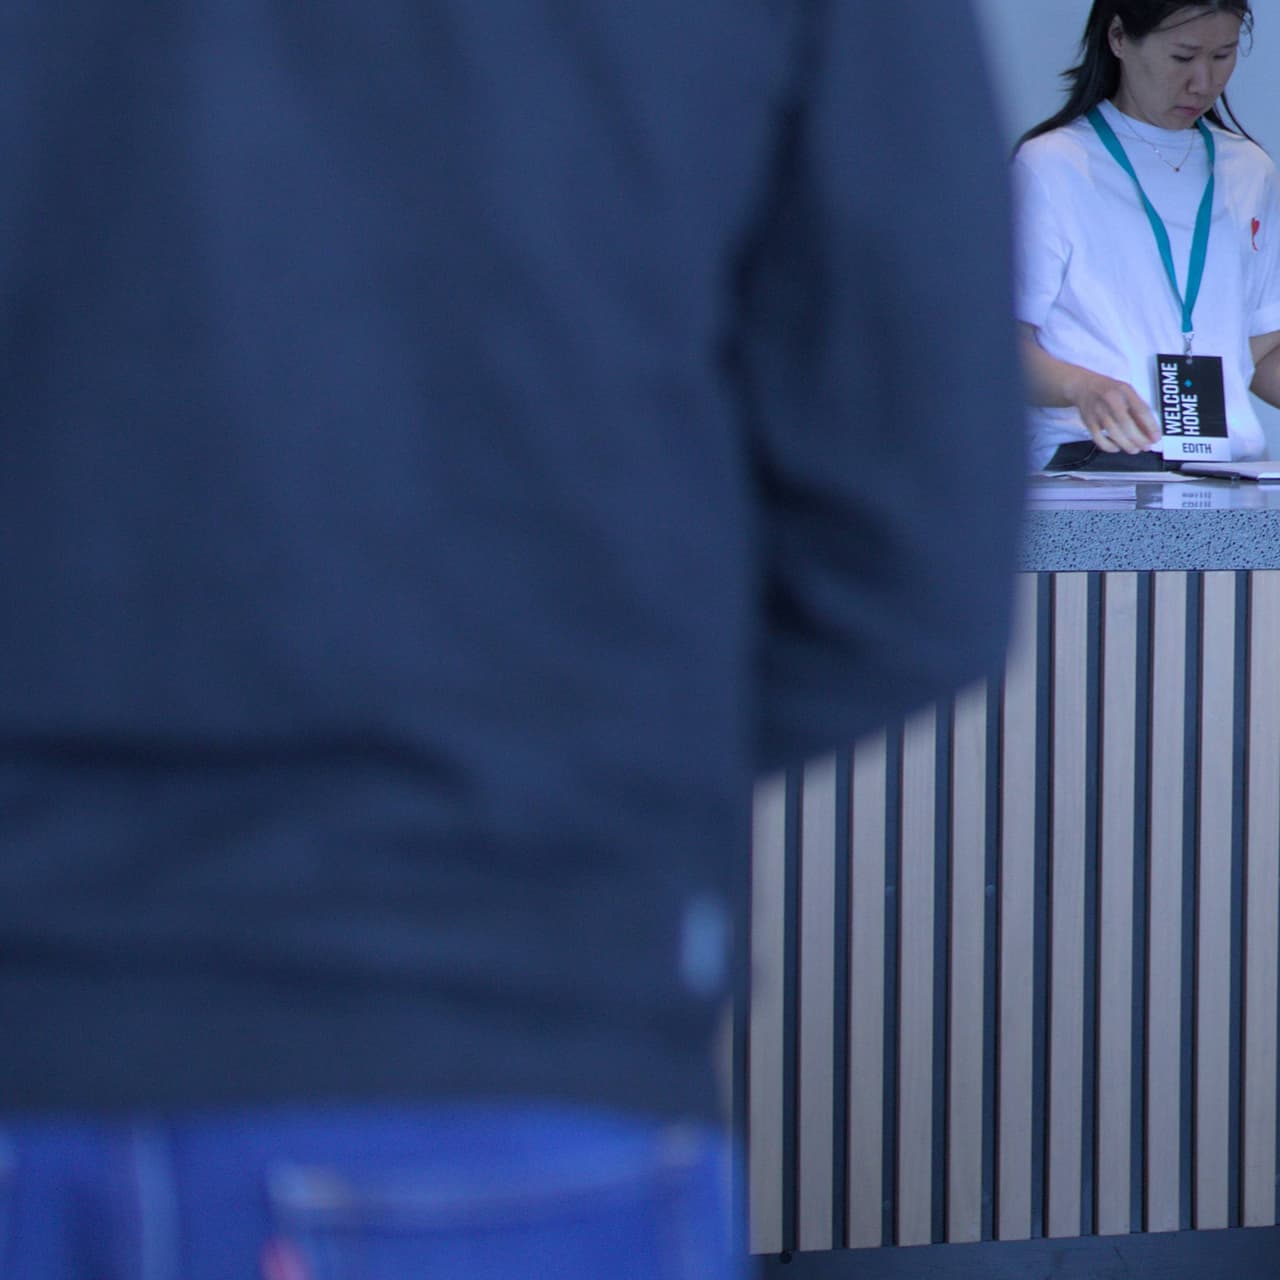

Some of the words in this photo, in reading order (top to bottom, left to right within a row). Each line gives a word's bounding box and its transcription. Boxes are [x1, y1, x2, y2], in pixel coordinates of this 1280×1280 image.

[1160, 362, 1182, 435] WELCOME
[1181, 393, 1200, 436] HOME
[1181, 441, 1212, 455] EDITH
